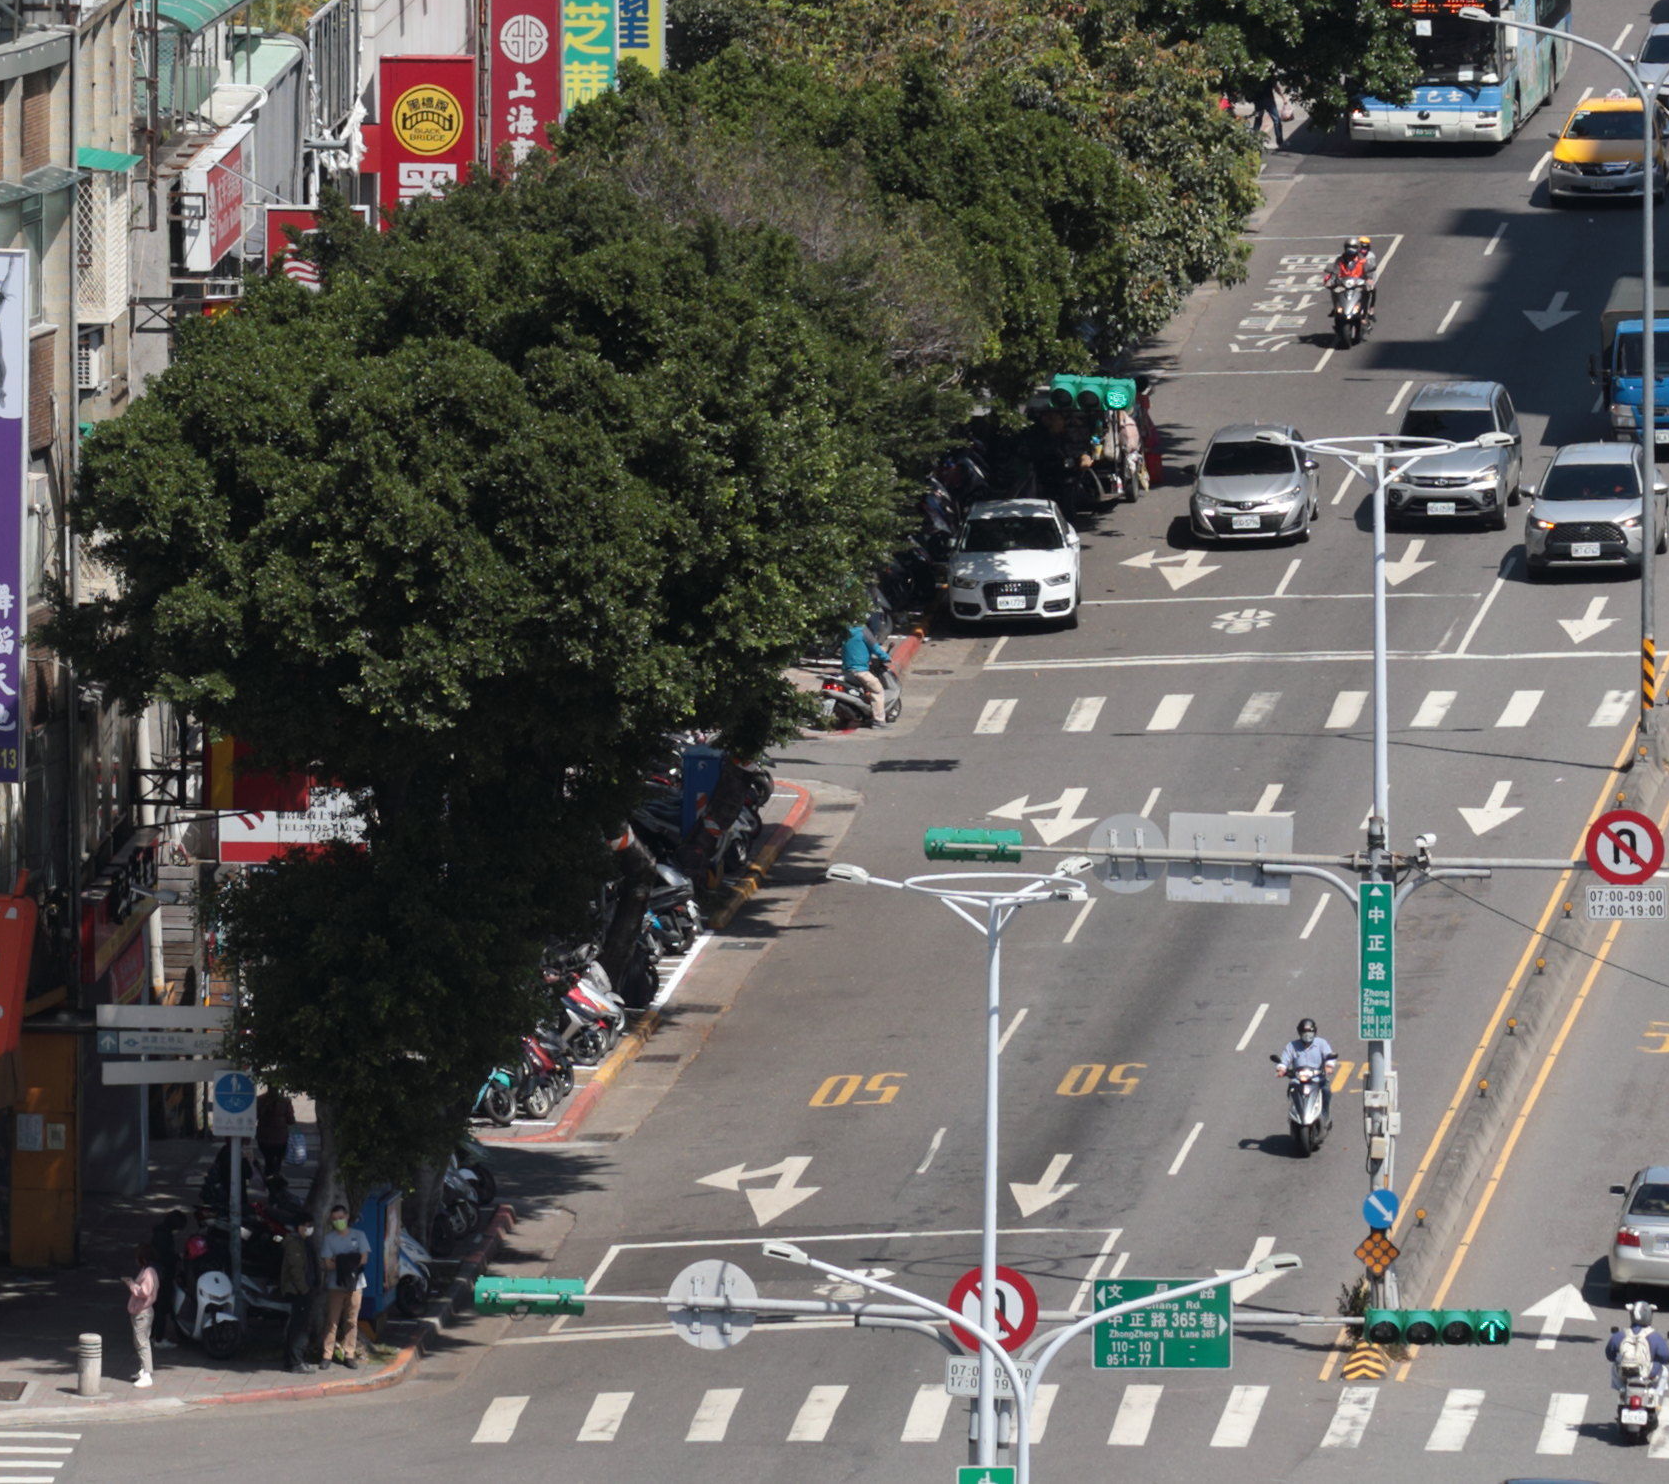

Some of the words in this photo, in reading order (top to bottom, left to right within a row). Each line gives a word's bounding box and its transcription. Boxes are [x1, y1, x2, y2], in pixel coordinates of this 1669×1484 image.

[413, 126, 440, 135] BLACK
[408, 133, 446, 143] BRIDGE
[1590, 890, 1663, 903] 07:00-09:00
[1590, 904, 1663, 917] 17:00-19:00
[1367, 905, 1386, 982] 中正路
[1363, 988, 1390, 999] Zhong
[1363, 997, 1390, 1008] Zheng
[1056, 1062, 1148, 1097] 50
[809, 1072, 909, 1108] 50
[1185, 1299, 1203, 1310] Rd.
[1108, 1312, 1218, 1328] 中正路365巷
[1108, 1330, 1159, 1340] ZhongZheng
[1179, 1330, 1200, 1339] Lane
[1201, 1330, 1216, 1339] 365
[1138, 1354, 1152, 1366] 77
